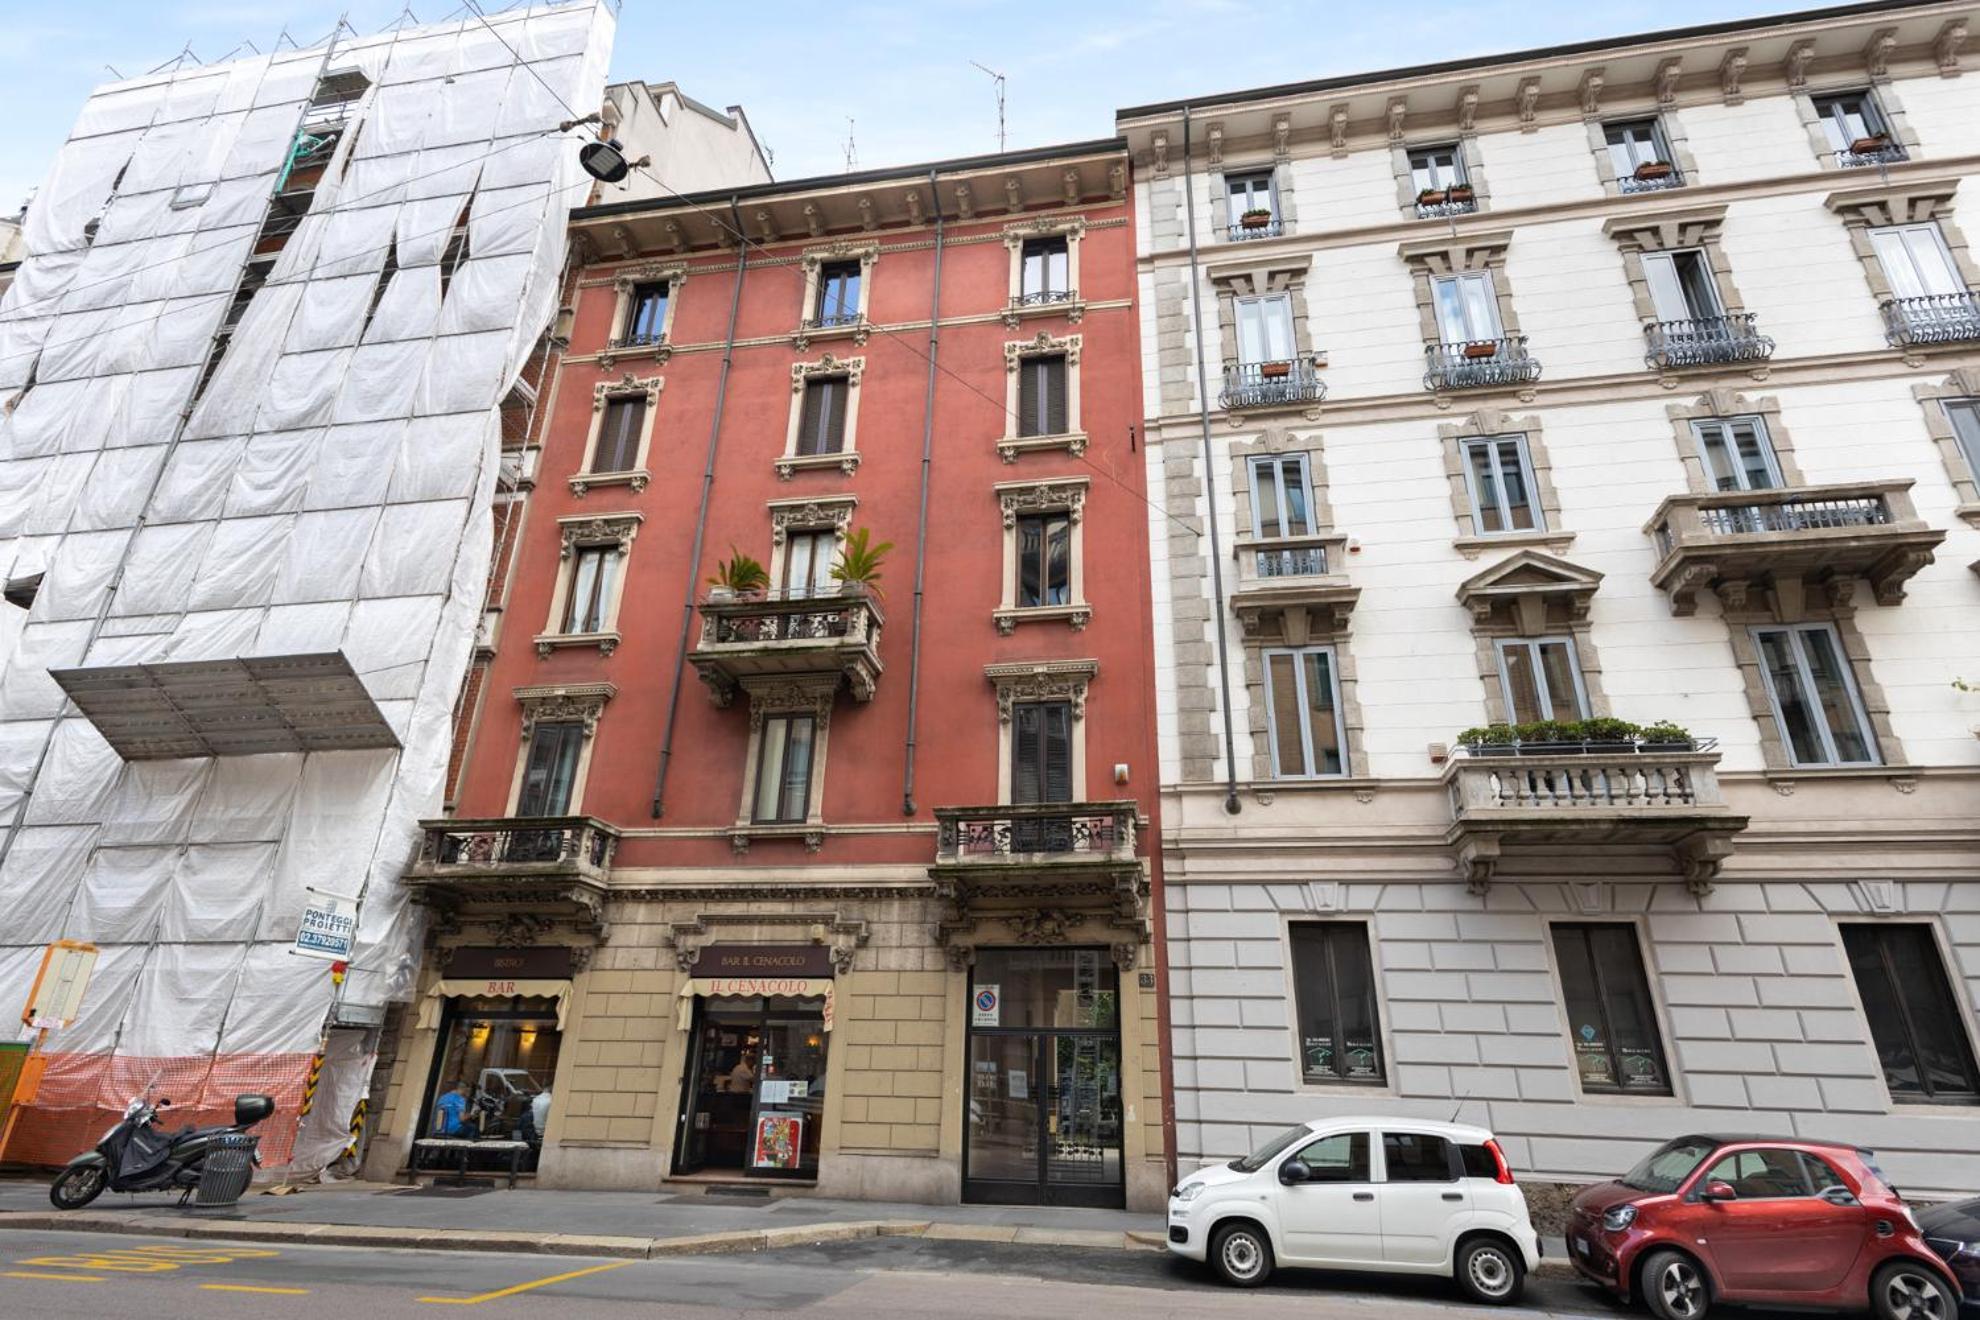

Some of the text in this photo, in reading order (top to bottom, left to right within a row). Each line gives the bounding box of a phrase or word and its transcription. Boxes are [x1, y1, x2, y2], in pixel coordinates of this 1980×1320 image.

[305, 909, 353, 926] PONTEGGI
[303, 917, 351, 933] PROIETTI
[721, 956, 806, 966] BAR IL CENACOLO
[487, 981, 516, 994] BAR
[711, 980, 808, 992] IL CENACOLO
[15, 1244, 281, 1272] BUS
